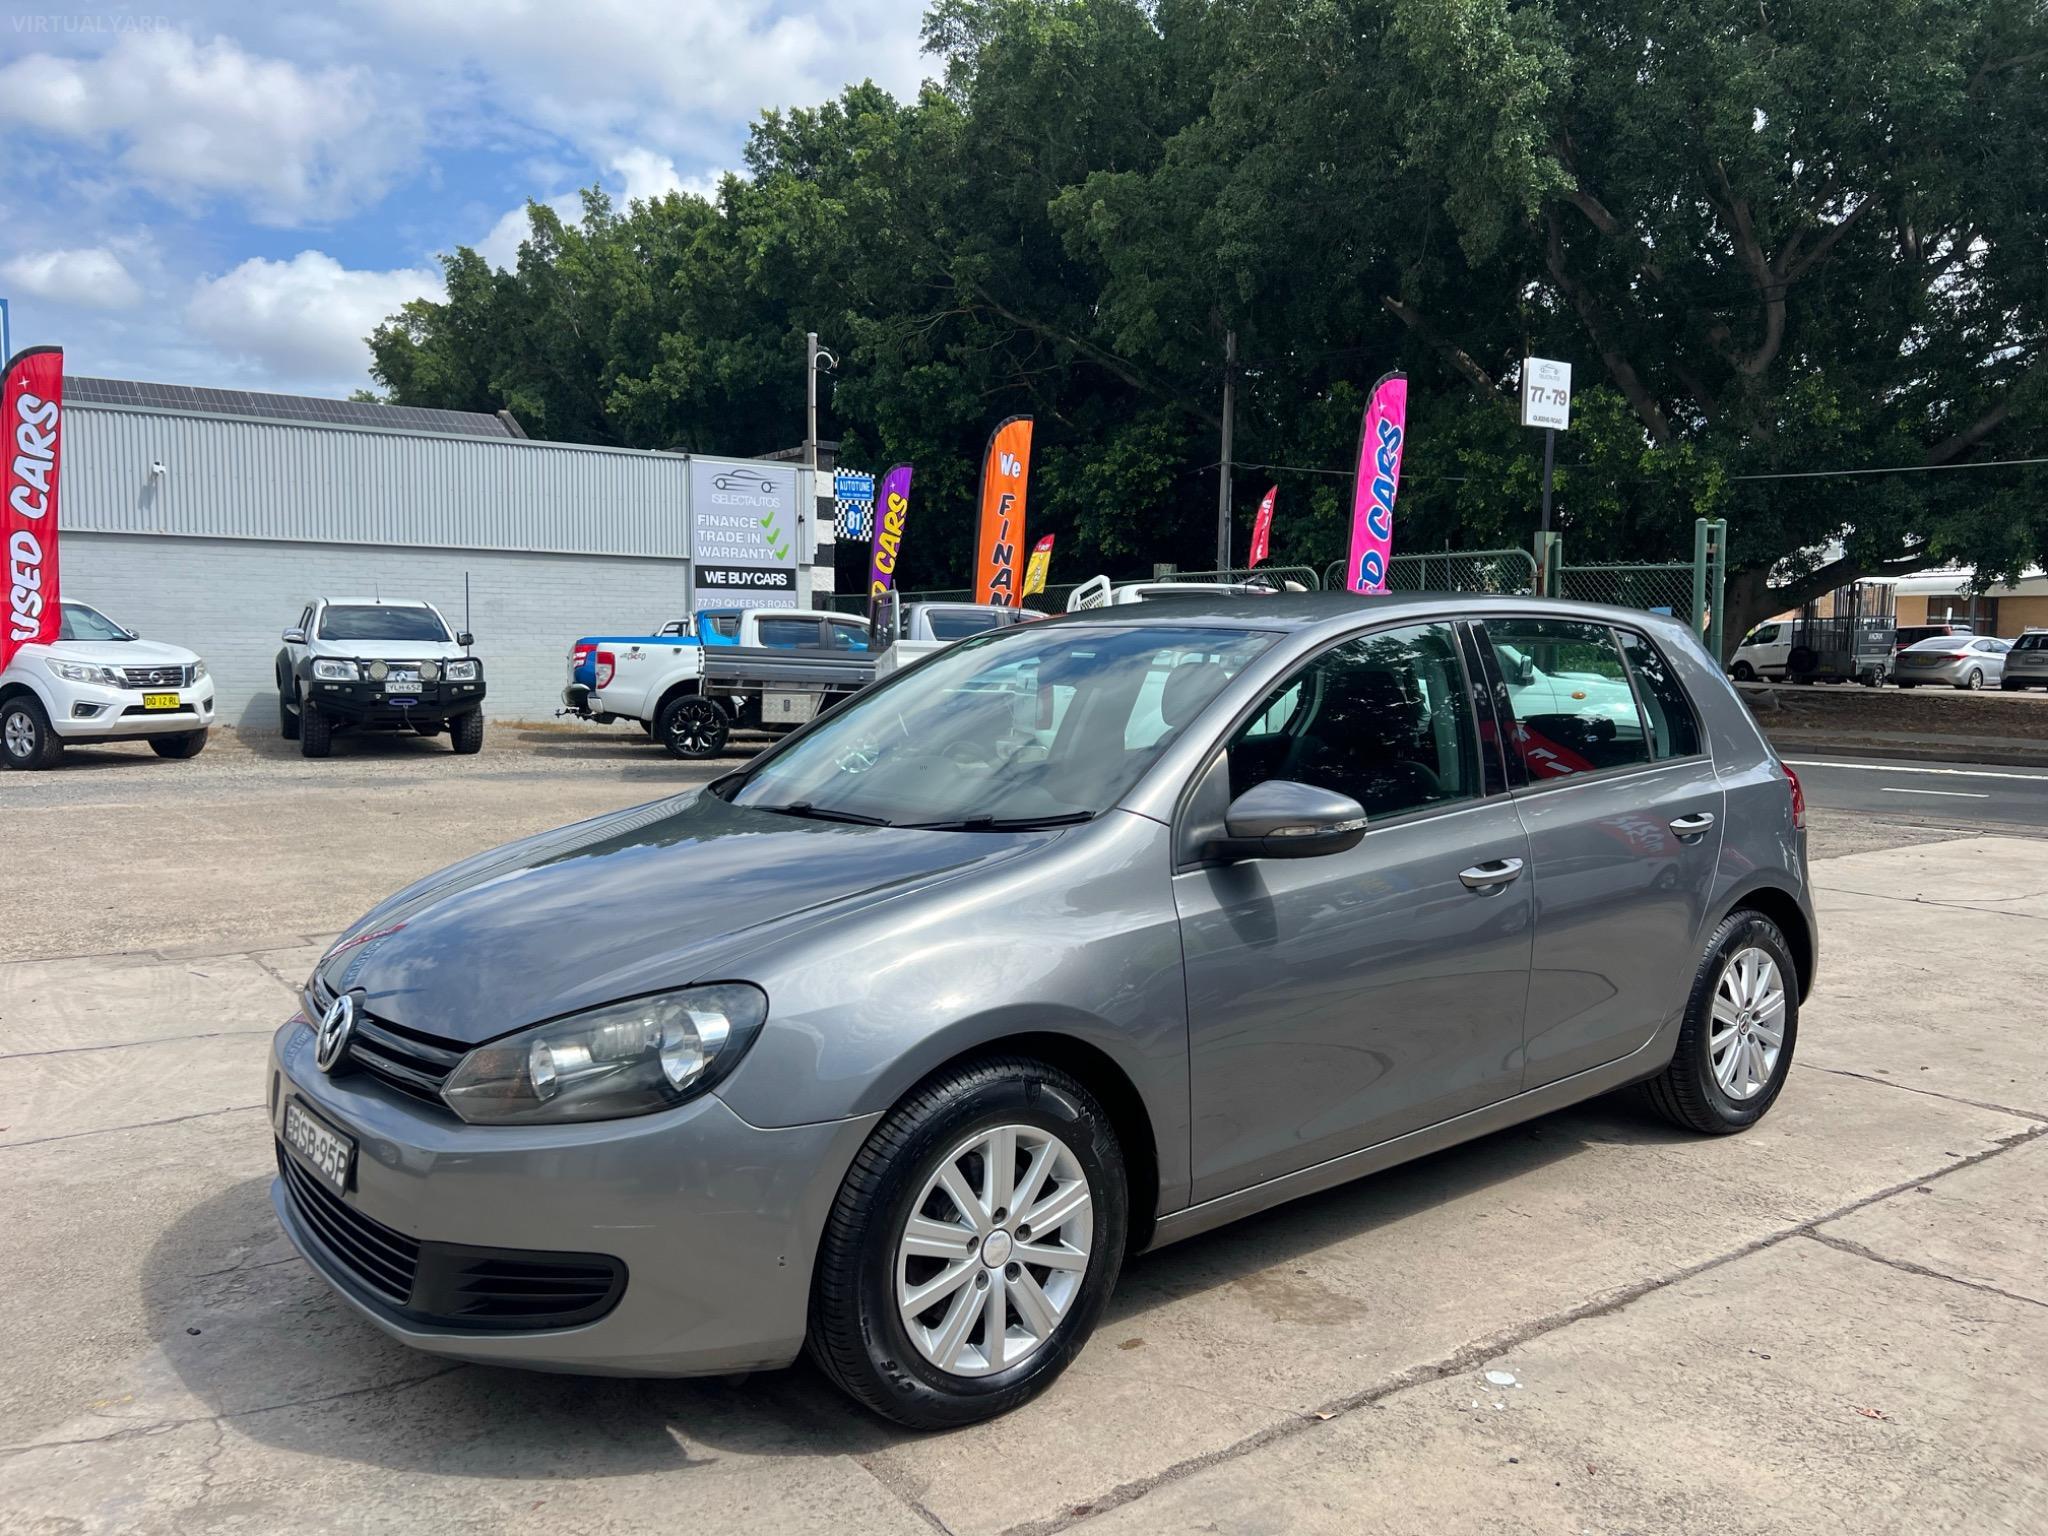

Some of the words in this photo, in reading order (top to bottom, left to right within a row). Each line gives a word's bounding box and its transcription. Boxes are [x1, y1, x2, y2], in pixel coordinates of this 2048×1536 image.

[9, 391, 60, 520] CARS
[1000, 452, 1022, 478] We
[840, 480, 870, 491] AUTOTUNE
[1366, 416, 1404, 542] CARS
[697, 514, 758, 529] FINANCE
[847, 510, 861, 530] 81
[697, 530, 744, 543] TRADE
[747, 533, 761, 544] IN
[875, 492, 908, 575] CARS
[698, 546, 776, 560] WARRANTY
[9, 529, 44, 643] USED
[704, 571, 727, 584] WE
[728, 572, 753, 585] BUY
[754, 573, 788, 586] CARS
[724, 598, 766, 608] QUEENS
[767, 599, 796, 609] ROAD
